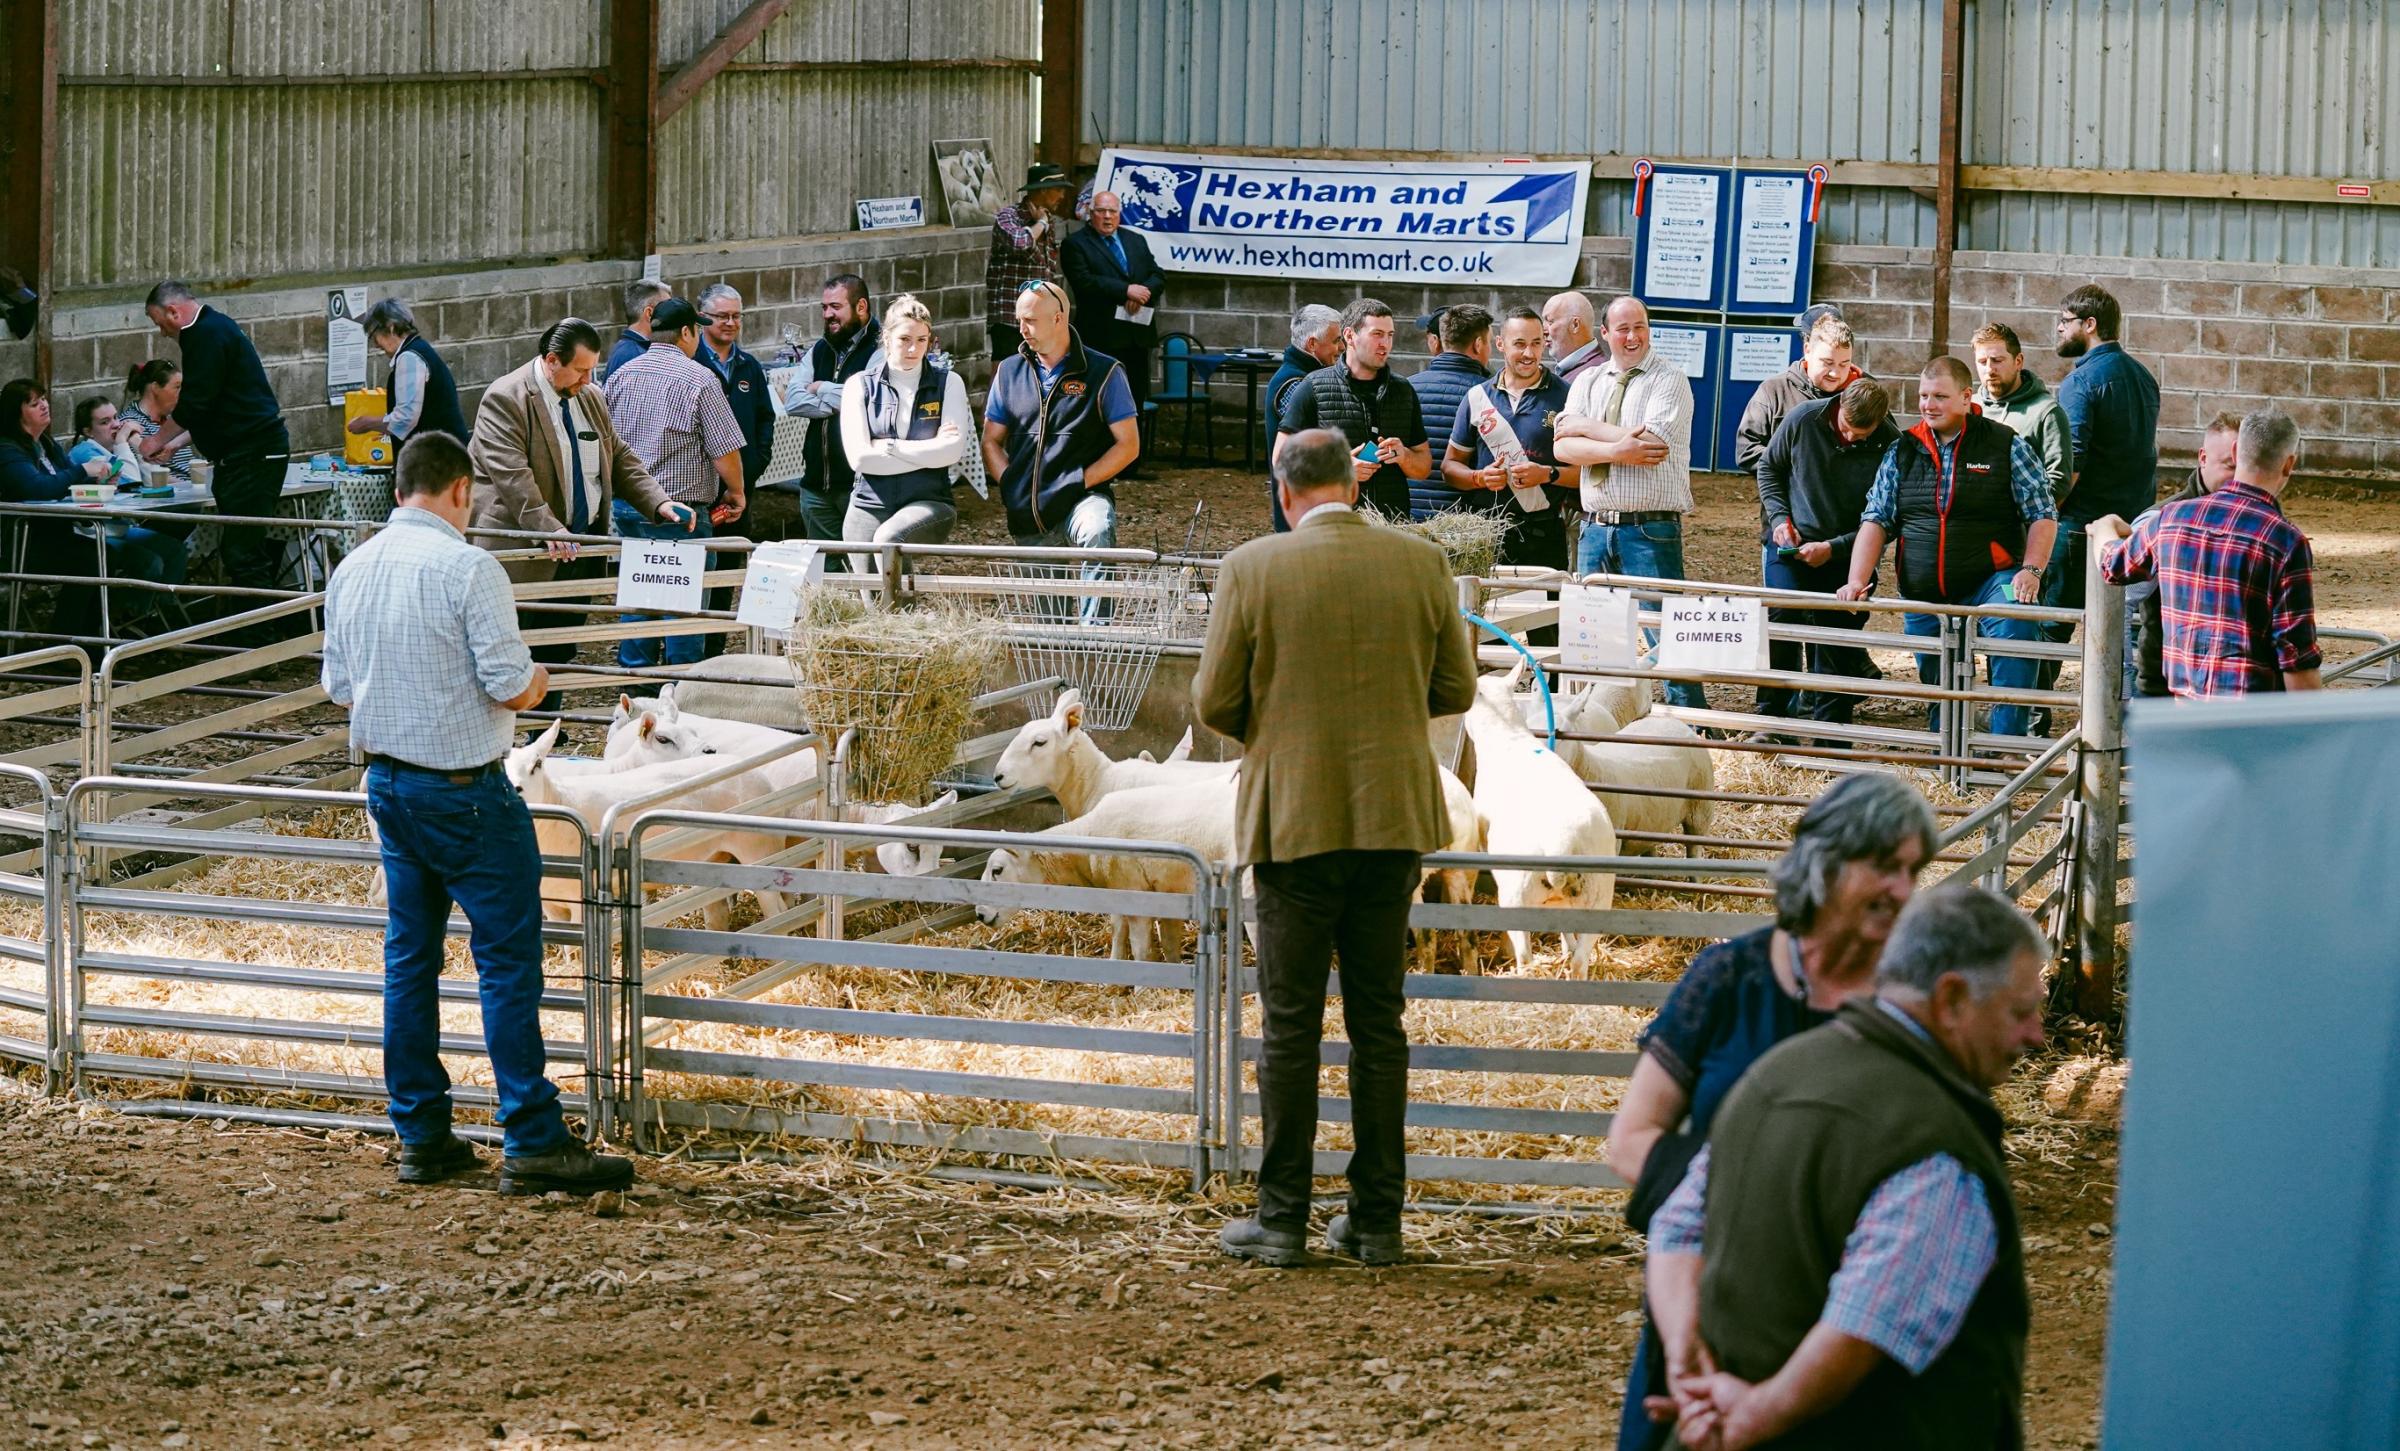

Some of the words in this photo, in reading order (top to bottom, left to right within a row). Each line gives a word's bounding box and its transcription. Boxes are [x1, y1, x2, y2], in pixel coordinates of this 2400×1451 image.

[1205, 173, 1377, 205] Hexham
[1390, 180, 1468, 205] and
[872, 203, 894, 213] Hexham
[896, 202, 906, 211] and
[873, 215, 899, 225] Northern
[1198, 203, 1384, 233] Northern
[1397, 211, 1516, 237] Marts
[1170, 243, 1494, 273] www.hexhammart.co.uk
[1966, 462, 1991, 470] Harbro
[643, 553, 683, 567] TEXEL
[632, 572, 691, 586] GIMMERS
[1673, 611, 1702, 622] NCC
[1707, 612, 1717, 622] X
[1721, 612, 1748, 623] BLT
[1675, 631, 1743, 643] GIMMERS
